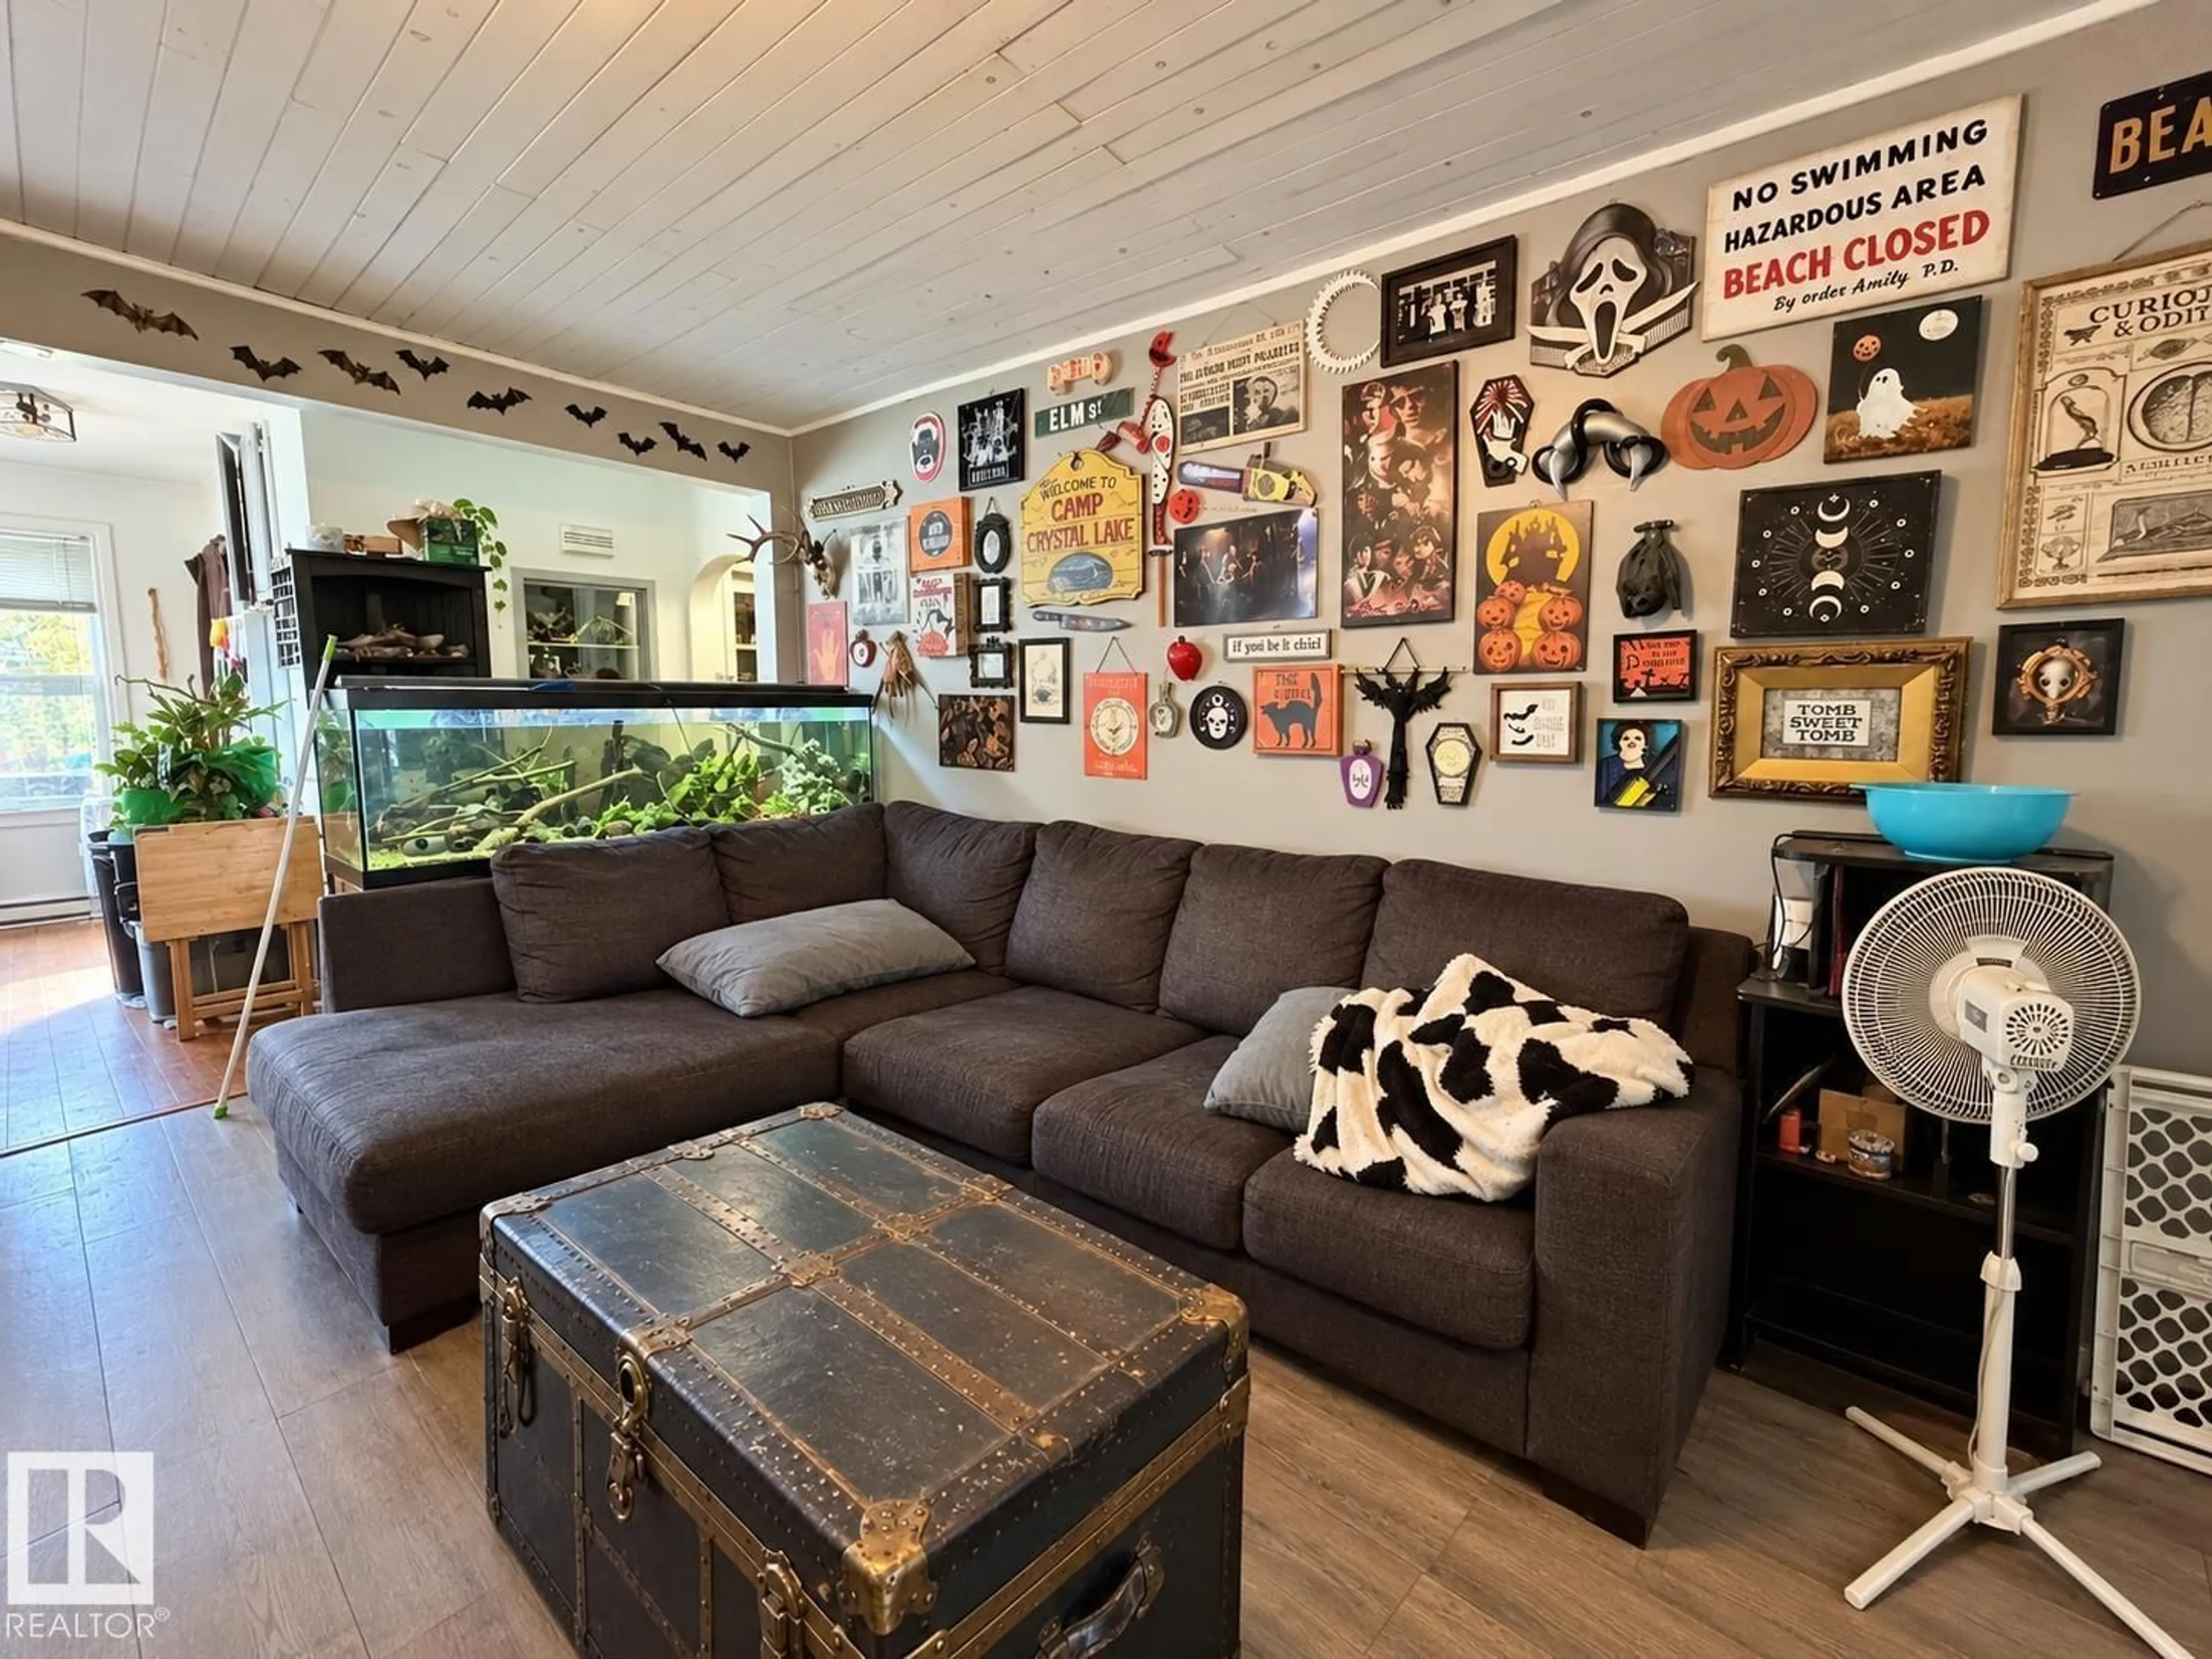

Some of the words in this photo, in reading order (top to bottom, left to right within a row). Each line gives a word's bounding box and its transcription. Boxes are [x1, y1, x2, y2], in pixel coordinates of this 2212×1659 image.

[1733, 181, 1778, 211] NO
[1791, 119, 1988, 194] SWIMMING
[1725, 192, 1882, 253] HAZARDOUS
[1891, 164, 1986, 210] AREA
[1724, 245, 1832, 299] BEACH
[1844, 209, 1990, 271] CLOSED
[1774, 296, 1796, 313] By
[1922, 259, 1959, 278] P.D.
[2114, 320, 2133, 337] &
[1050, 402, 1084, 431] ELM
[1100, 476, 1116, 488] TO
[1051, 493, 1103, 522] CAMP
[1027, 525, 1088, 553] CRYSTAL
[1094, 518, 1134, 544] LAKE
[1790, 716, 1863, 729] SWEET
[1797, 704, 1856, 715] TOMB
[1796, 730, 1855, 742] TOMB
